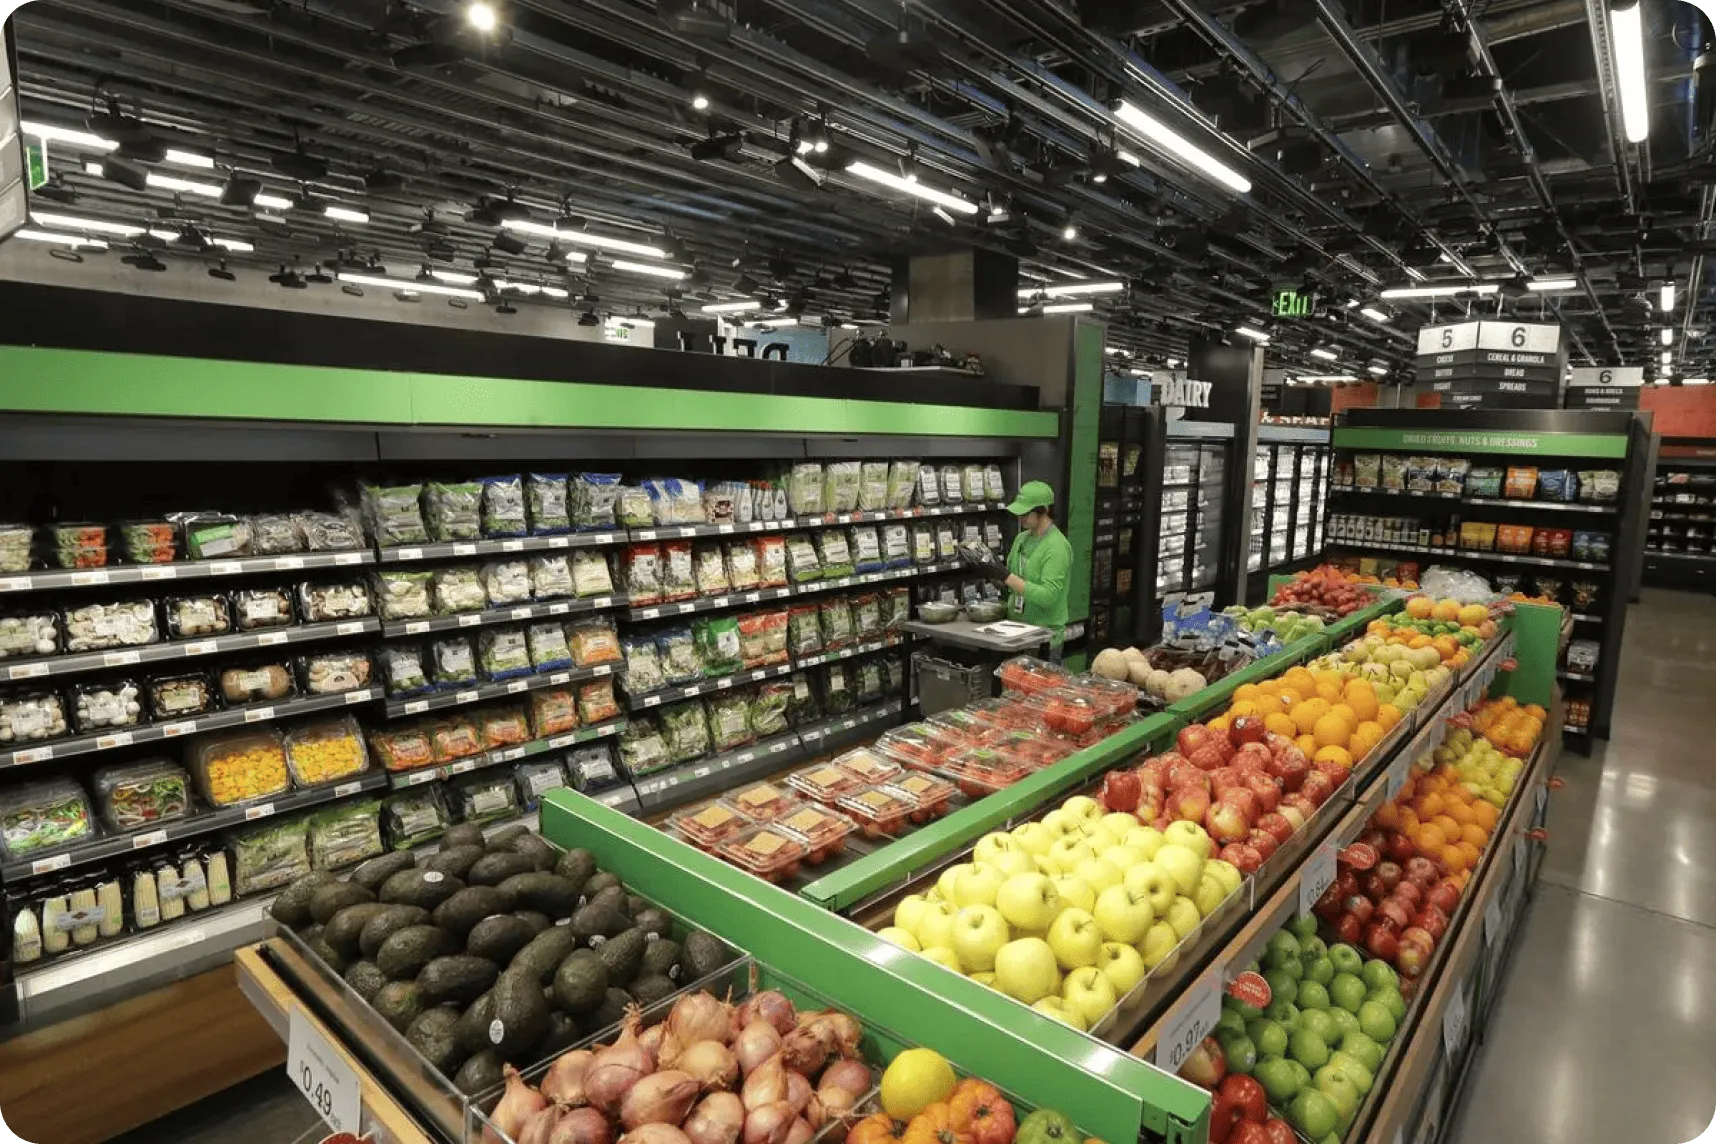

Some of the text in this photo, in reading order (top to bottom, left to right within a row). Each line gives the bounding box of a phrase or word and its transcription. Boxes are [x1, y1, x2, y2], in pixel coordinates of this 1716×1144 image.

[1442, 328, 1453, 348] 5
[1511, 327, 1526, 347] 6
[1599, 370, 1612, 384] 6
[1160, 376, 1213, 408] DAIRY
